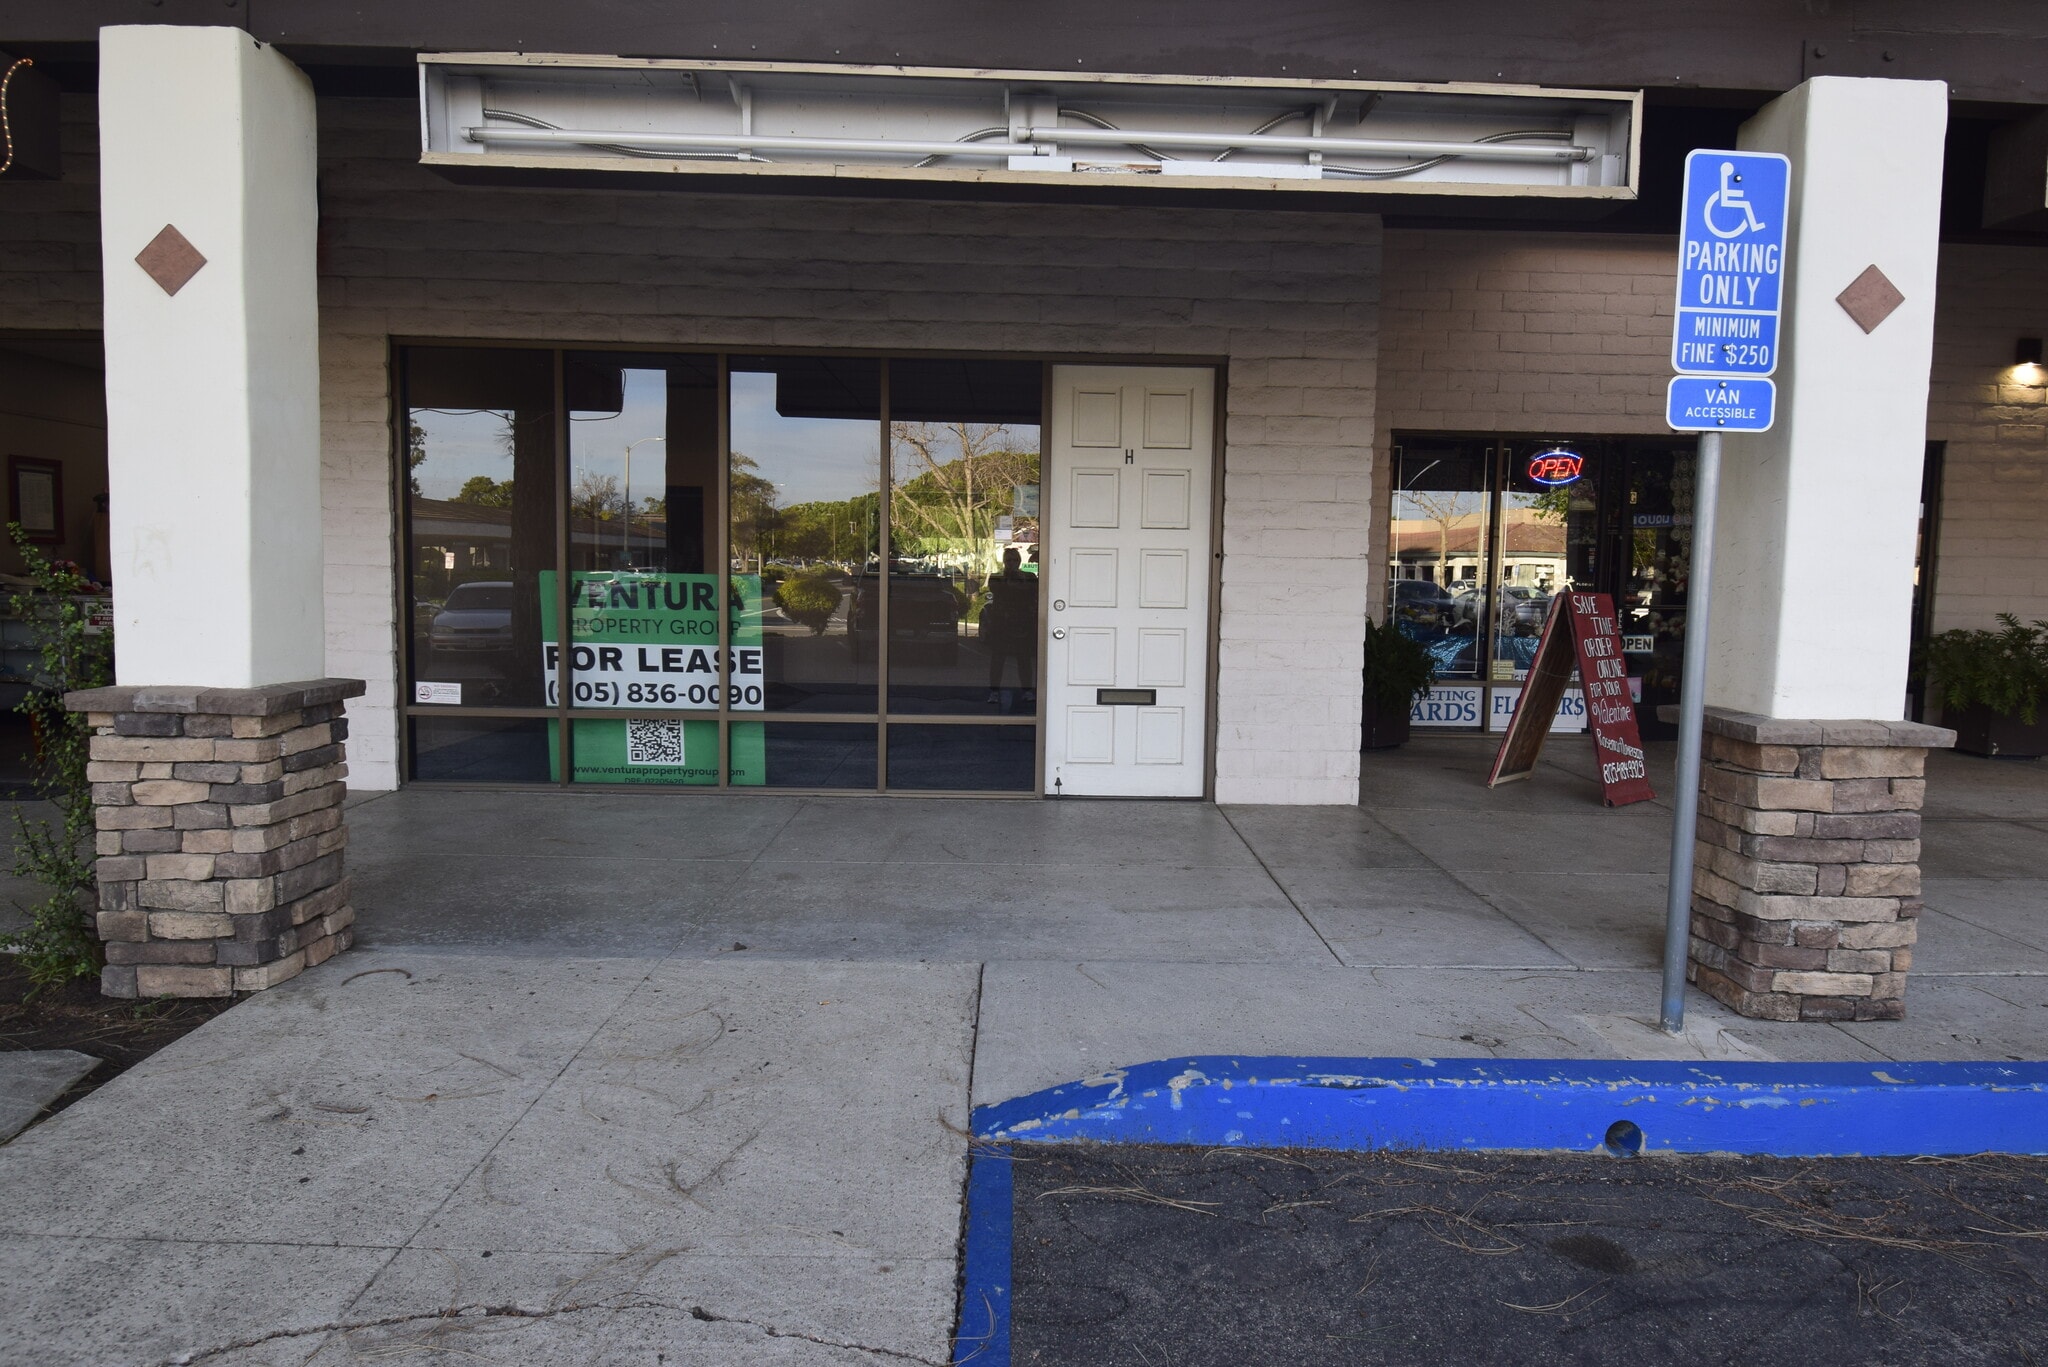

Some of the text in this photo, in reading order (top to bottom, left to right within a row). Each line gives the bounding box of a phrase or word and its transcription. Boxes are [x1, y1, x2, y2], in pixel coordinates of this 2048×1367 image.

[1686, 240, 1779, 275] PARKING
[1700, 273, 1761, 306] ONLY
[1694, 316, 1760, 339] MINIMUM
[1681, 342, 1769, 366] FINE $250
[1705, 389, 1740, 404] VAN
[1685, 406, 1756, 419] ACCESSIBLE
[1124, 448, 1134, 465] H
[1528, 457, 1584, 479] OPEN
[1572, 595, 1599, 614] SAVE
[571, 617, 741, 636] ROPERTY GROP
[1590, 617, 1615, 635] TIME
[1583, 637, 1614, 657] ORDER
[546, 645, 762, 675] FOR LEASE
[1596, 659, 1625, 679] ONLINE
[548, 680, 762, 705] (05) 836-0090
[1590, 680, 1622, 698] FOR YOUR
[1410, 703, 1476, 722] ARDS
[1493, 696, 1584, 716] FLRS
[1592, 698, 1631, 724] Valentine
[573, 765, 745, 778] www.venturapropertygroupom
